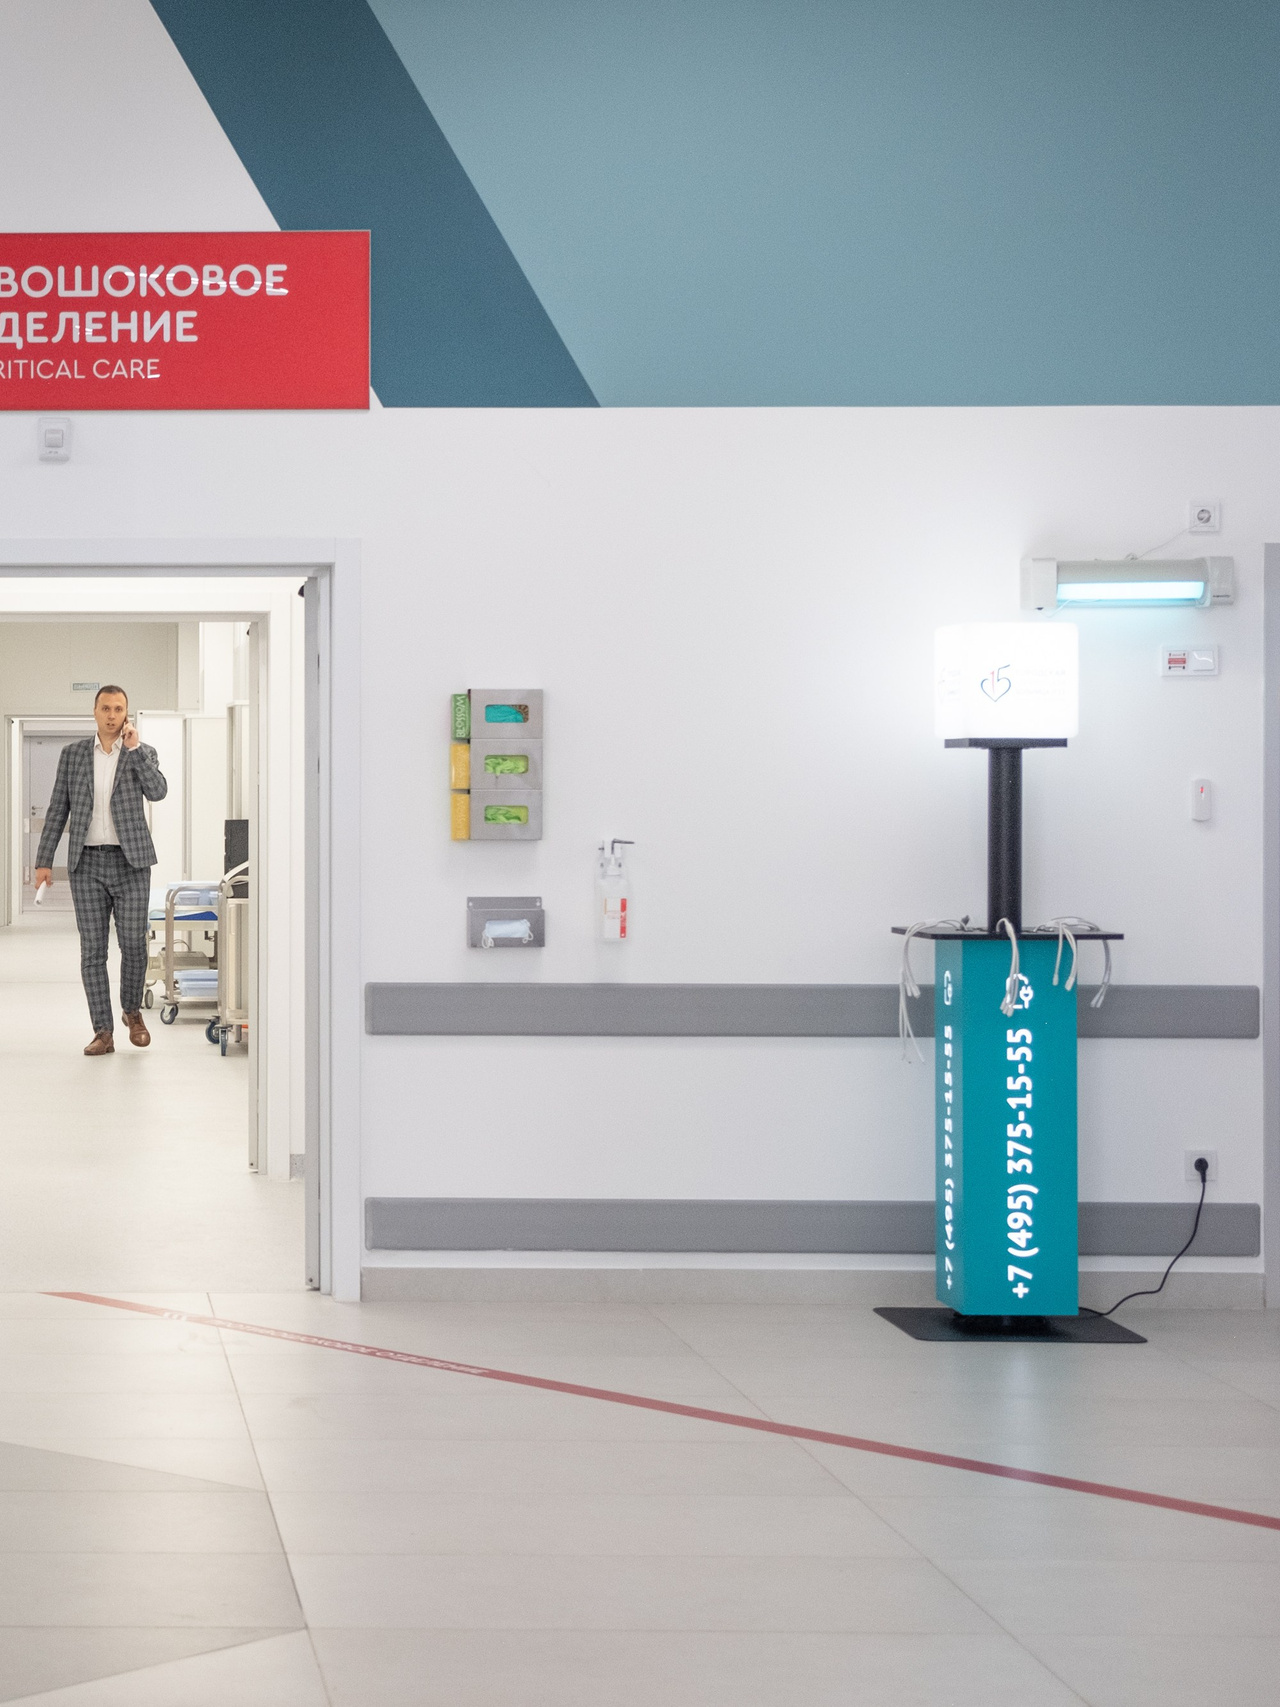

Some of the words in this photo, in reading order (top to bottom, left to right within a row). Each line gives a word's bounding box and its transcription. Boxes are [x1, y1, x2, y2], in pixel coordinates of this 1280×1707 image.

[92, 358, 160, 379] CARE
[455, 695, 466, 738] BLOSSOM
[1006, 1028, 1033, 1174] 375-15-55
[1006, 1184, 1039, 1258] (495)
[1007, 1264, 1033, 1298] +7
